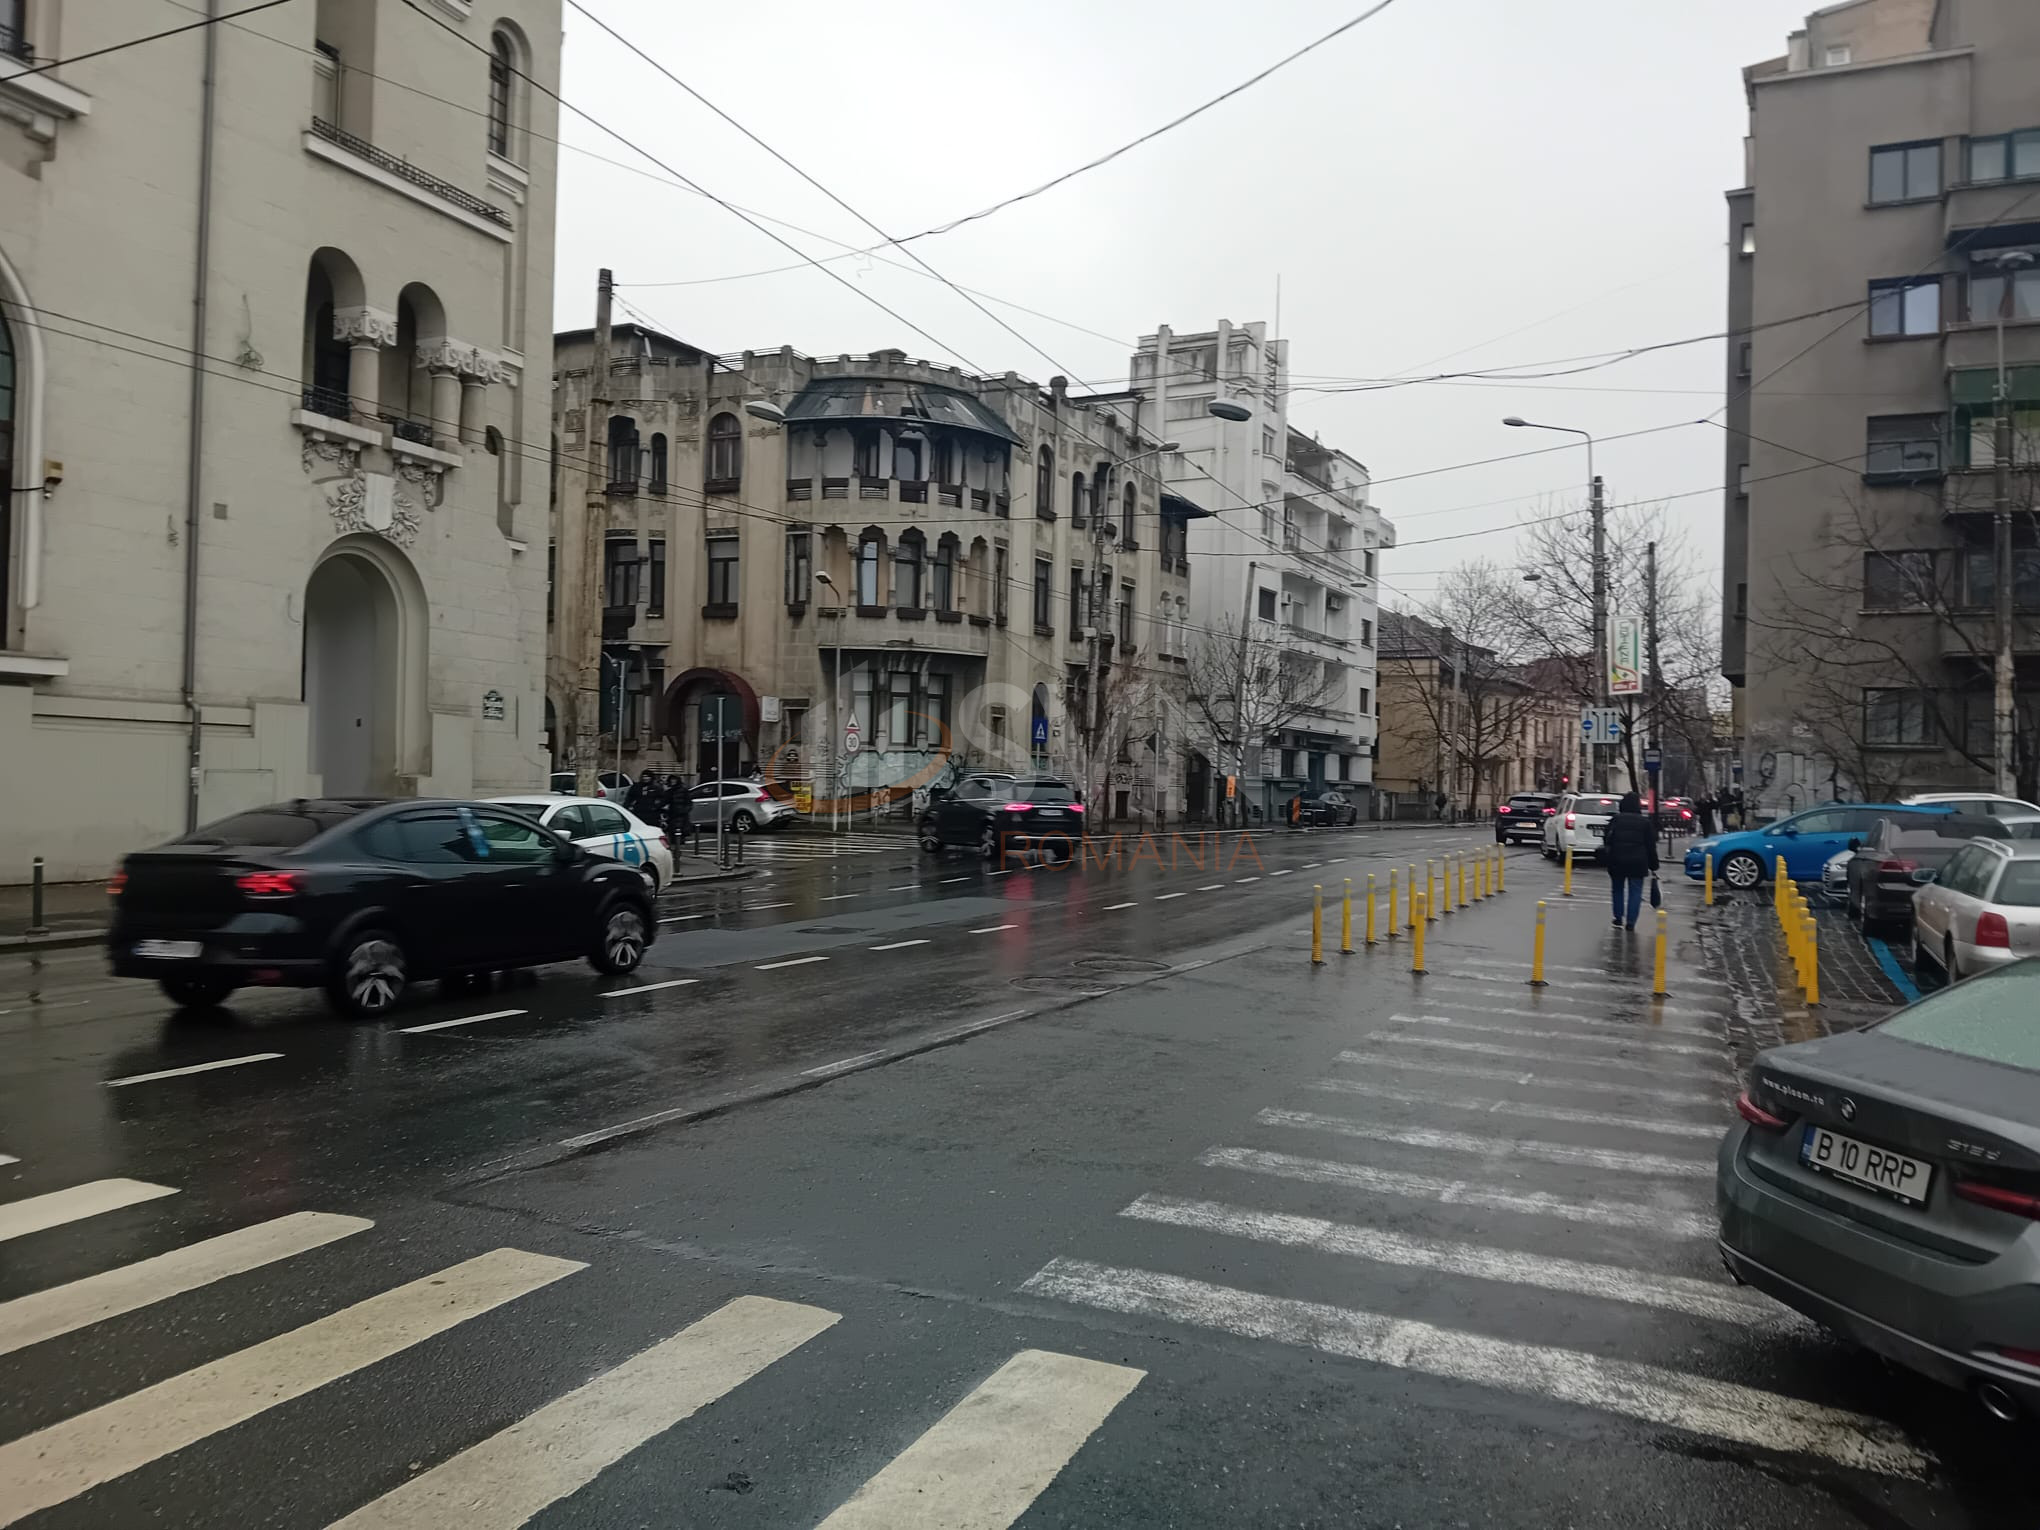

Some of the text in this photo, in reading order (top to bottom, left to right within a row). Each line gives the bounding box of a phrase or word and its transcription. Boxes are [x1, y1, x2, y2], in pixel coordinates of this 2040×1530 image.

[1817, 1132, 1833, 1161] B
[1840, 1140, 1859, 1171] 10
[1864, 1149, 1917, 1188] RRP
